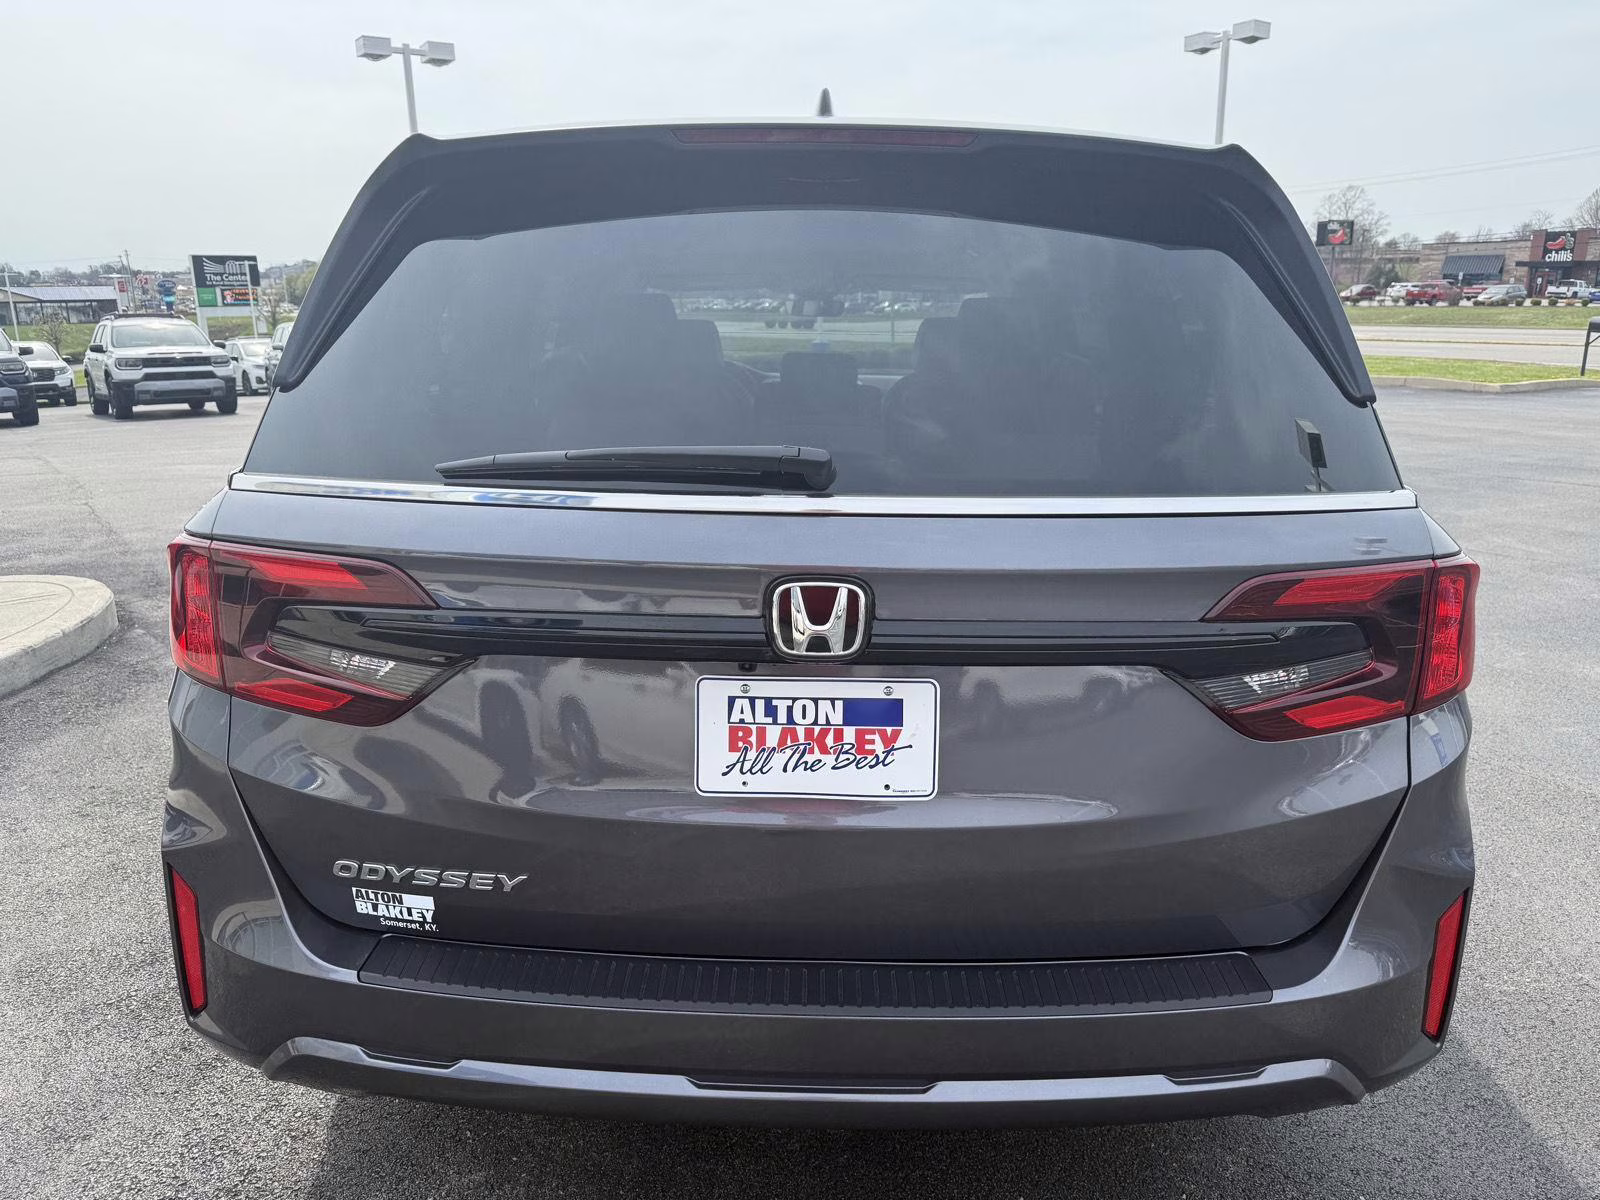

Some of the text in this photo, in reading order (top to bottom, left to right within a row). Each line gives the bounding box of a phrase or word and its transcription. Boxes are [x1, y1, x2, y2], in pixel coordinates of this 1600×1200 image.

[205, 273, 248, 281] The Cente
[729, 698, 844, 725] ALTON
[728, 726, 903, 757] BLAKLEY
[721, 741, 913, 777] All The Best
[332, 860, 528, 892] ODYSSEY
[355, 888, 404, 905] ALTON
[355, 901, 435, 923] BLAKLEY
[380, 917, 440, 932] Somerset, KY.
